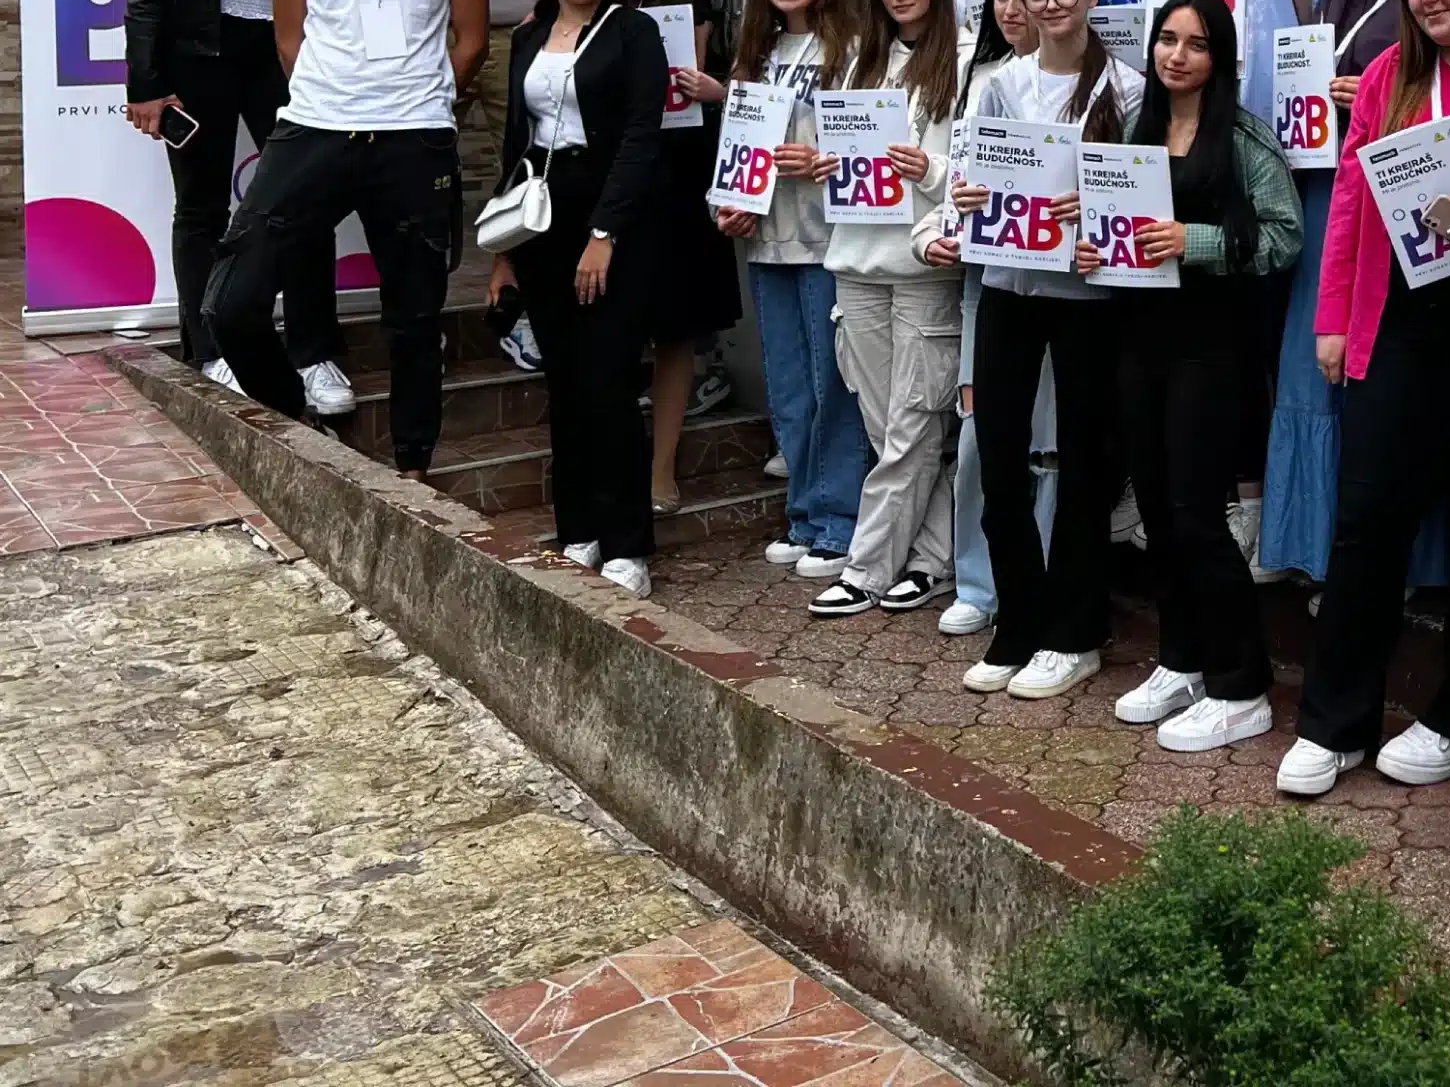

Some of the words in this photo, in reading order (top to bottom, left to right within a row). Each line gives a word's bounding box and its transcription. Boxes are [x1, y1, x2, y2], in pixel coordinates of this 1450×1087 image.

[57, 104, 99, 117] PRVI
[833, 113, 870, 122] KREIRAŠ
[1277, 95, 1328, 131] JOB
[720, 144, 773, 174] JOB
[976, 152, 1044, 168] BUDUĆNOST.
[977, 143, 986, 152] TI
[989, 145, 1035, 157] KREIRAŠ
[716, 159, 773, 196] LAB
[830, 157, 902, 189] JOB
[1376, 171, 1386, 180] TI
[1387, 152, 1433, 176] KREIRAŠ
[1378, 160, 1447, 189] BUDUĆNOST.
[829, 171, 904, 207] LAB
[973, 192, 1062, 226] JOB
[971, 209, 1063, 251] LAB
